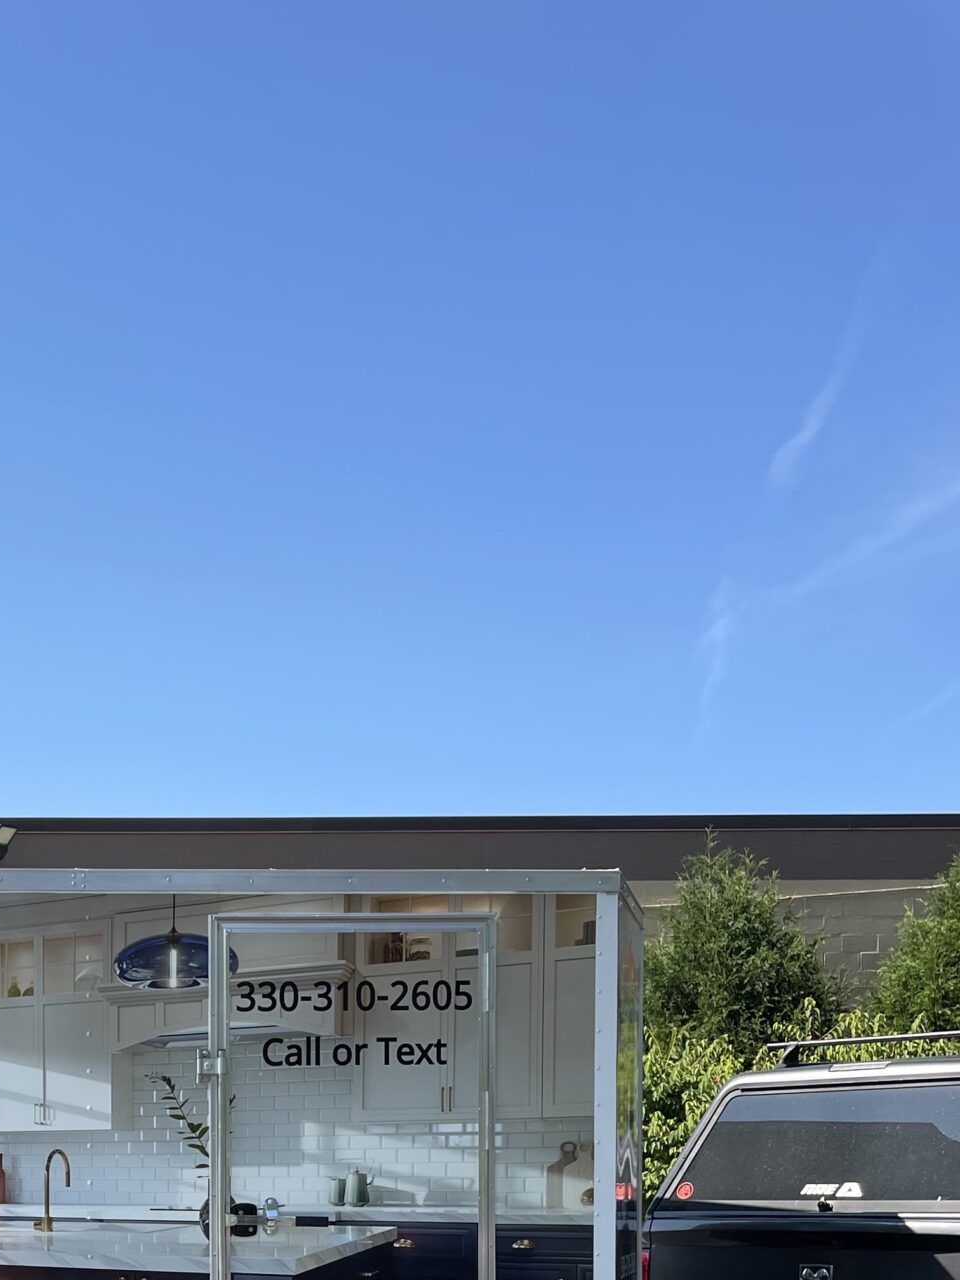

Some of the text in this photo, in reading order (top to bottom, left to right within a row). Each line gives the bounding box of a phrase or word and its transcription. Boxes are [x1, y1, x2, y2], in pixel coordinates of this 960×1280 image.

[236, 979, 473, 1012] 330-310-2605
[262, 1035, 447, 1067] Call or Text
